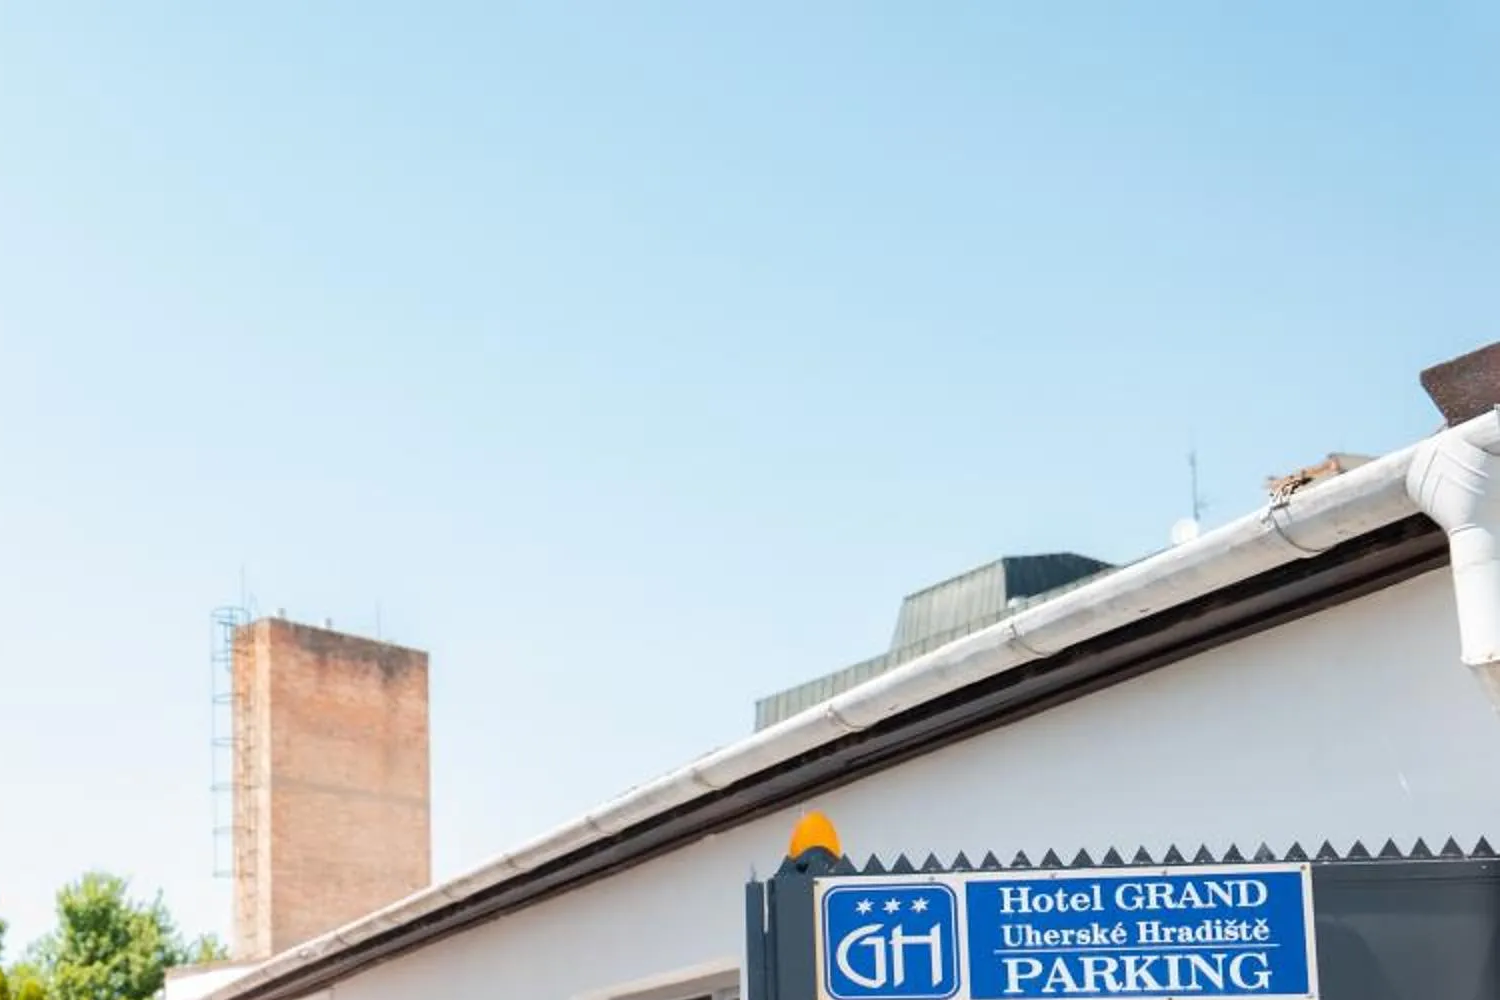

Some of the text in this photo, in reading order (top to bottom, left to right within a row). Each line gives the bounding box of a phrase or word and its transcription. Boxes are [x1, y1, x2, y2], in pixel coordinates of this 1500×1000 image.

[1000, 879, 1268, 914] Hotel GRAND
[1002, 918, 1269, 947] Uherské Hradiště
[835, 923, 943, 989] GH
[1002, 951, 1272, 995] PARKING
